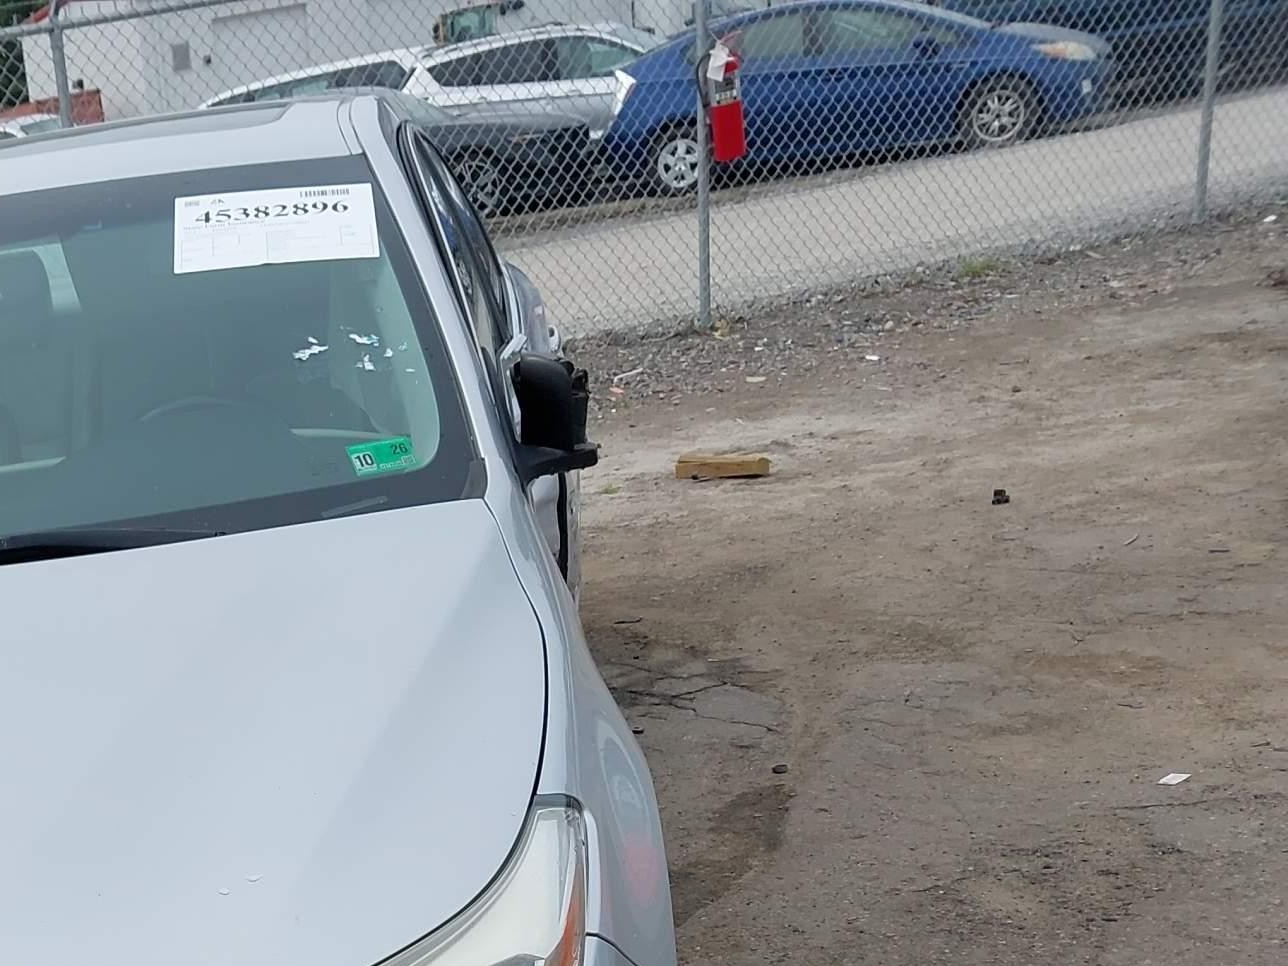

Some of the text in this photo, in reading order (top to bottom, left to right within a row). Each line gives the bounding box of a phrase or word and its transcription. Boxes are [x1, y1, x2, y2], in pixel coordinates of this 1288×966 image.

[195, 199, 349, 224] 45382896
[390, 442, 409, 455] 26
[354, 453, 375, 468] 10
